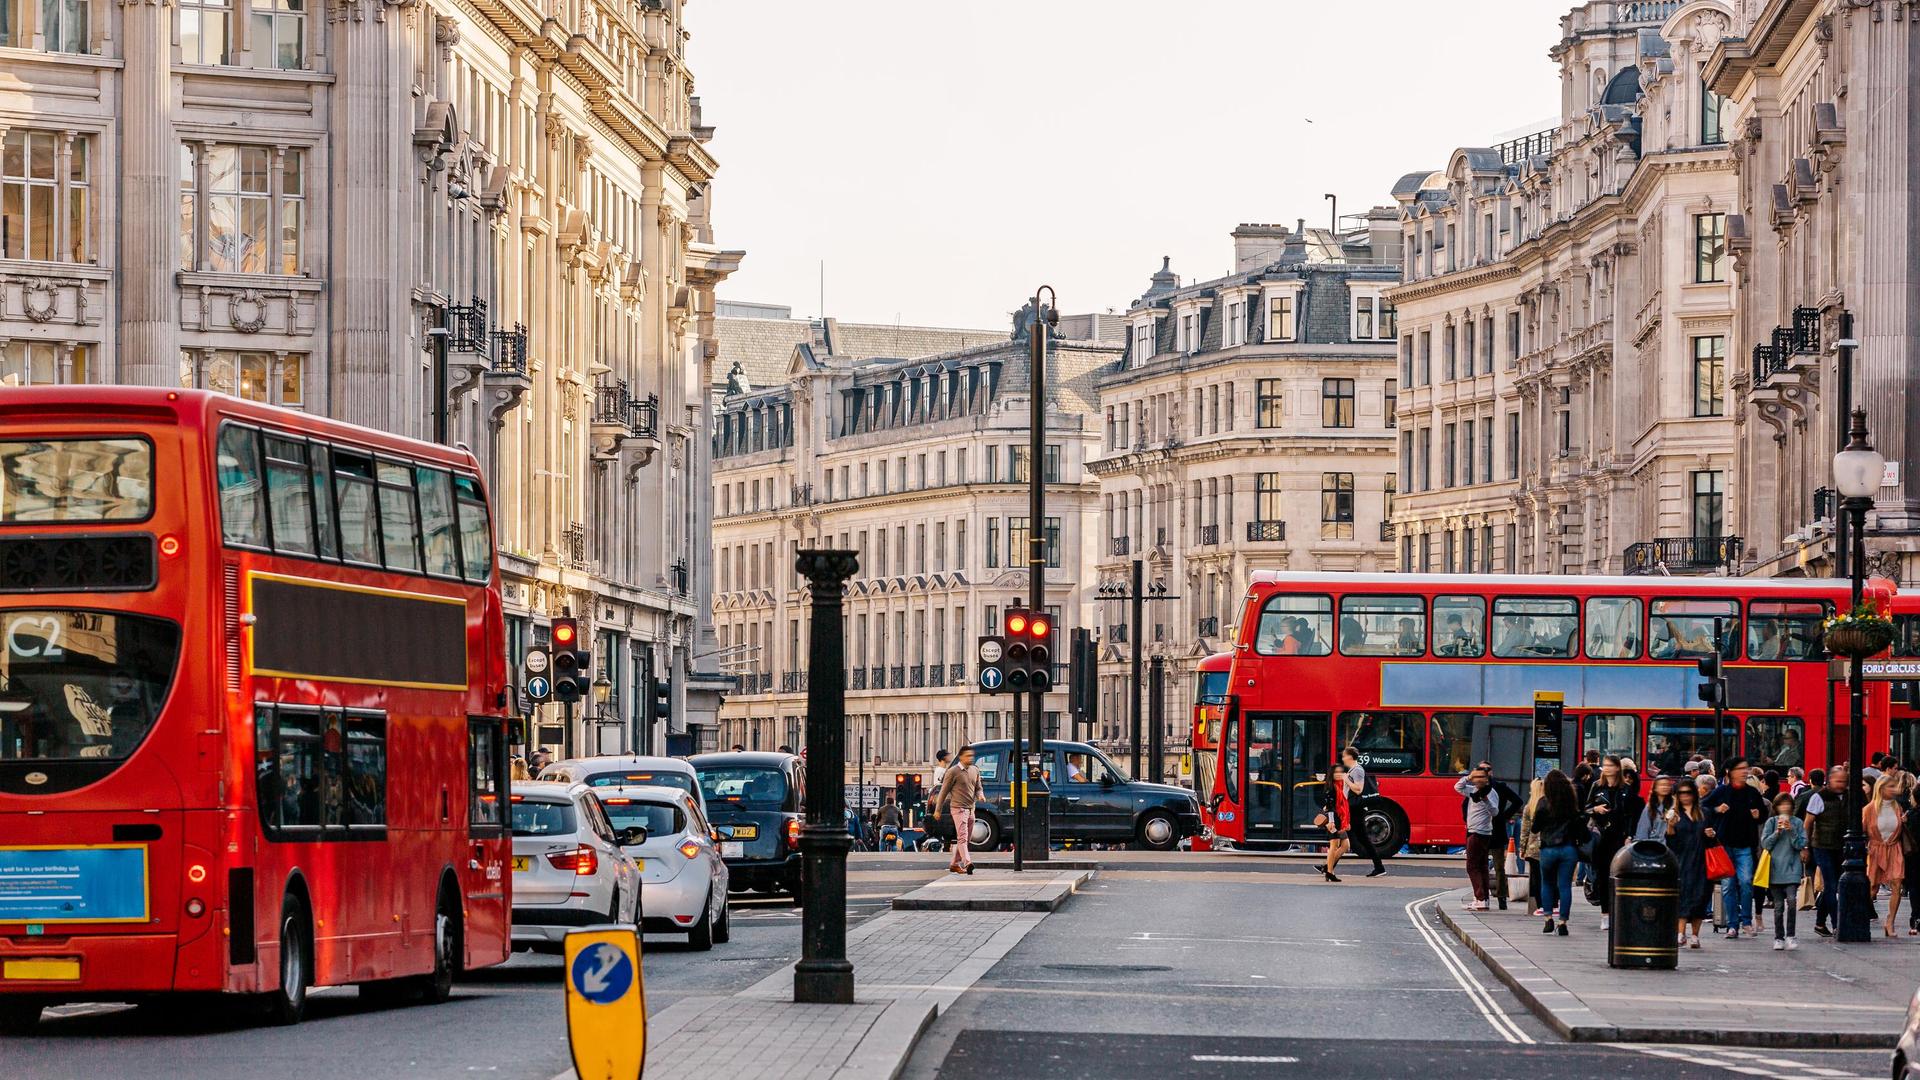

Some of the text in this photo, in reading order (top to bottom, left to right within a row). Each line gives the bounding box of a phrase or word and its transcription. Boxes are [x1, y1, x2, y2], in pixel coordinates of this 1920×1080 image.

[8, 616, 63, 657] C2
[1862, 664, 1884, 673] FORD
[1886, 664, 1916, 673] CIRCUS
[1357, 755, 1370, 765] 39
[45, 865, 68, 873] birthday
